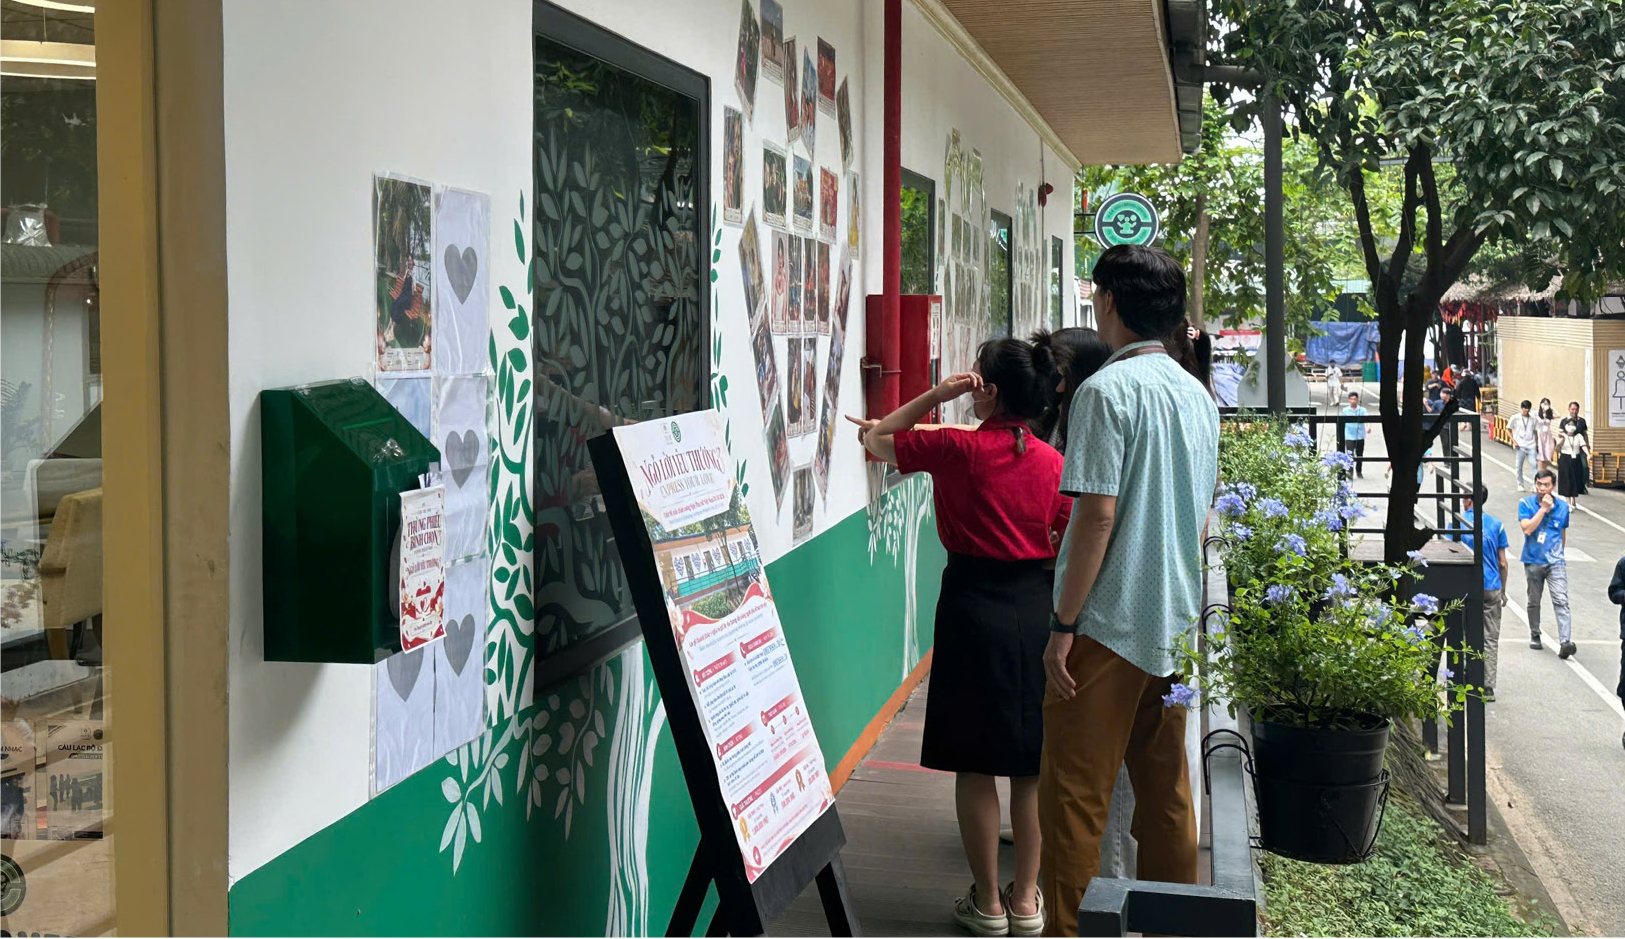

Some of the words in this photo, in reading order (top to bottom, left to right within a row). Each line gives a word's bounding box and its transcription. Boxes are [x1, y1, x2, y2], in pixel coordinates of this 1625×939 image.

[660, 480, 685, 498] EXPRESS
[684, 475, 701, 490] YOUR
[700, 473, 715, 485] LOVE
